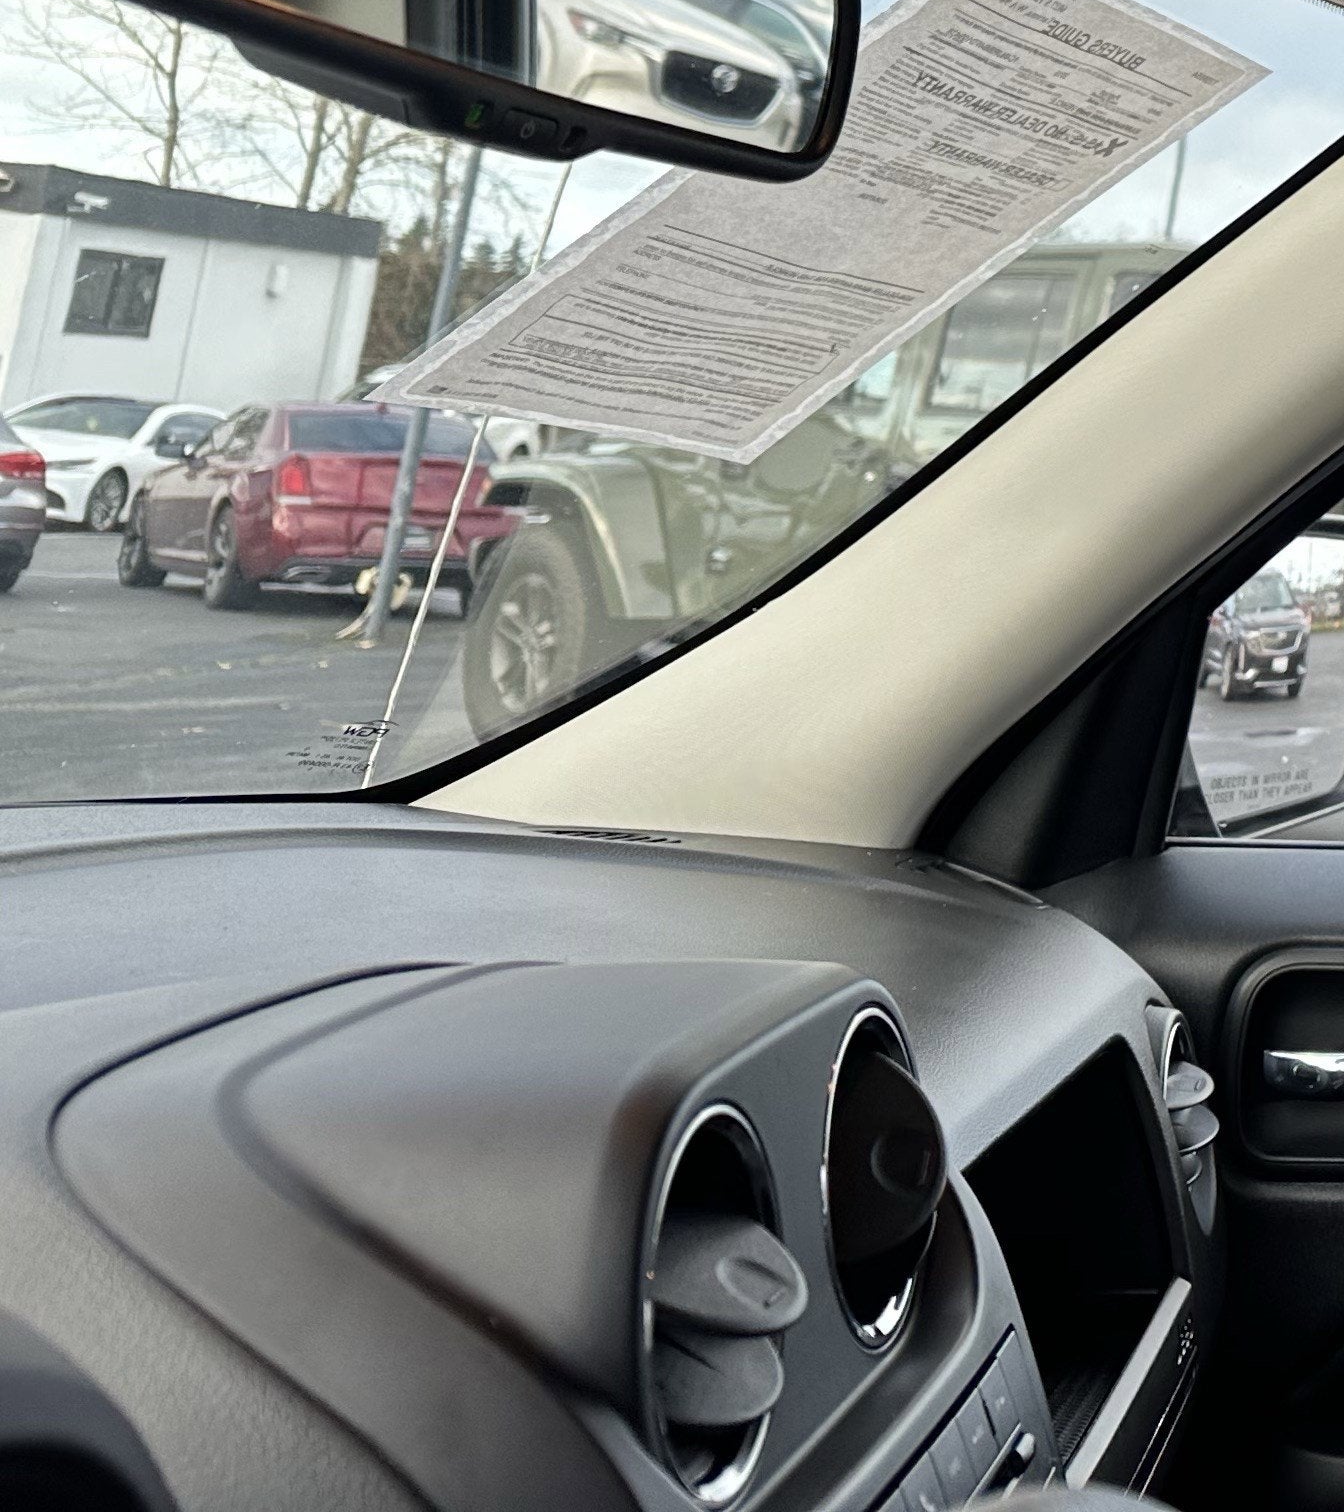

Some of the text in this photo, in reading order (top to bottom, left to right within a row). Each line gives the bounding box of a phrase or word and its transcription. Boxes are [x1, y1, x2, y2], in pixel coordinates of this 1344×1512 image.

[1210, 775, 1248, 790] OBJECTS
[1250, 774, 1260, 786] IN
[1295, 768, 1310, 781] ARE
[1239, 789, 1259, 801] THAN
[1262, 785, 1281, 798] THEY
